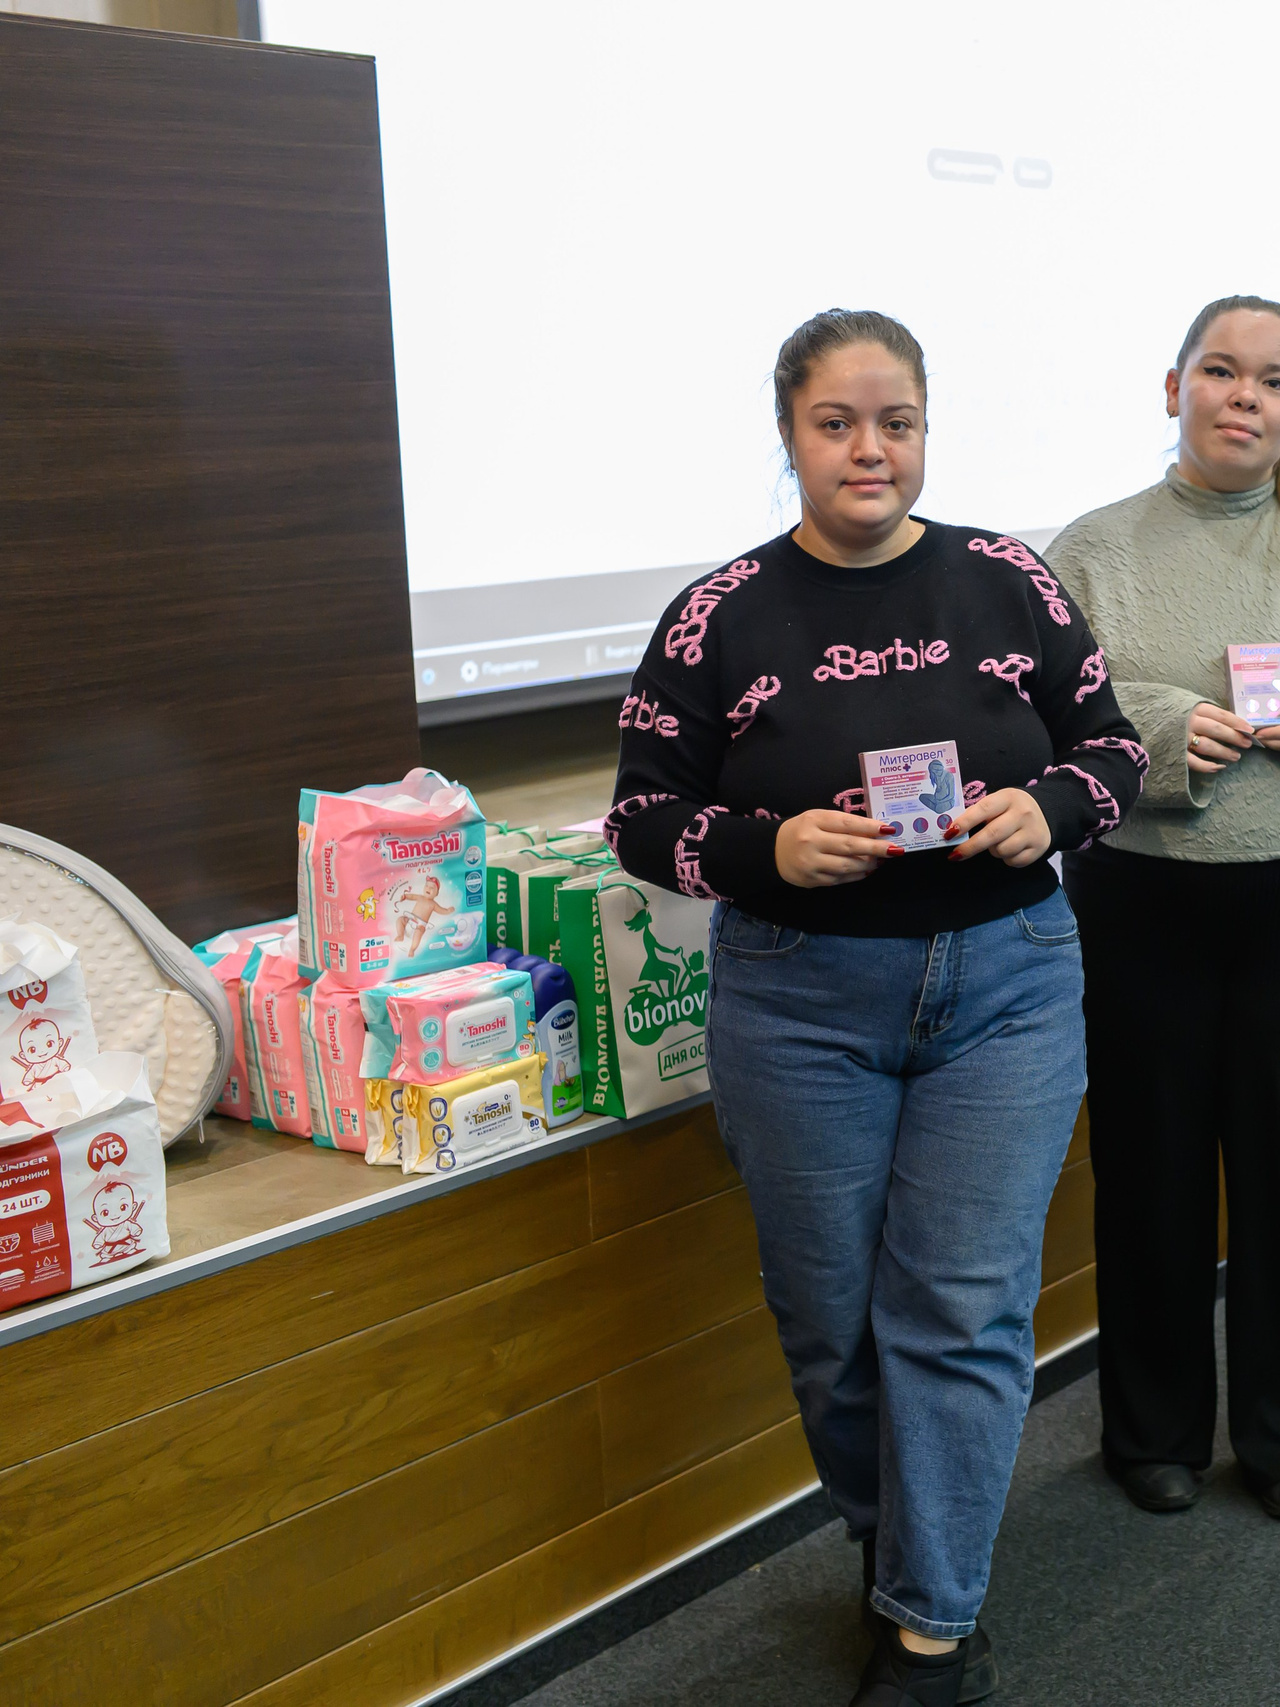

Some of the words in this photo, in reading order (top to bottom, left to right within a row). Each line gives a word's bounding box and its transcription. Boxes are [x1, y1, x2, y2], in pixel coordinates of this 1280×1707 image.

[968, 535, 1072, 628] Barbie
[665, 558, 760, 667] Barbie
[813, 637, 951, 683] Barbie
[879, 750, 944, 767] Митеравел
[365, 939, 376, 948] 26
[361, 950, 368, 960] 2
[558, 1032, 573, 1044] Milk
[519, 1043, 529, 1051] 80
[663, 1048, 688, 1072] ДНЯ
[351, 1113, 358, 1123] 26
[530, 1118, 539, 1128] 80
[92, 1141, 125, 1163] NB
[2, 1203, 18, 1214] 24
